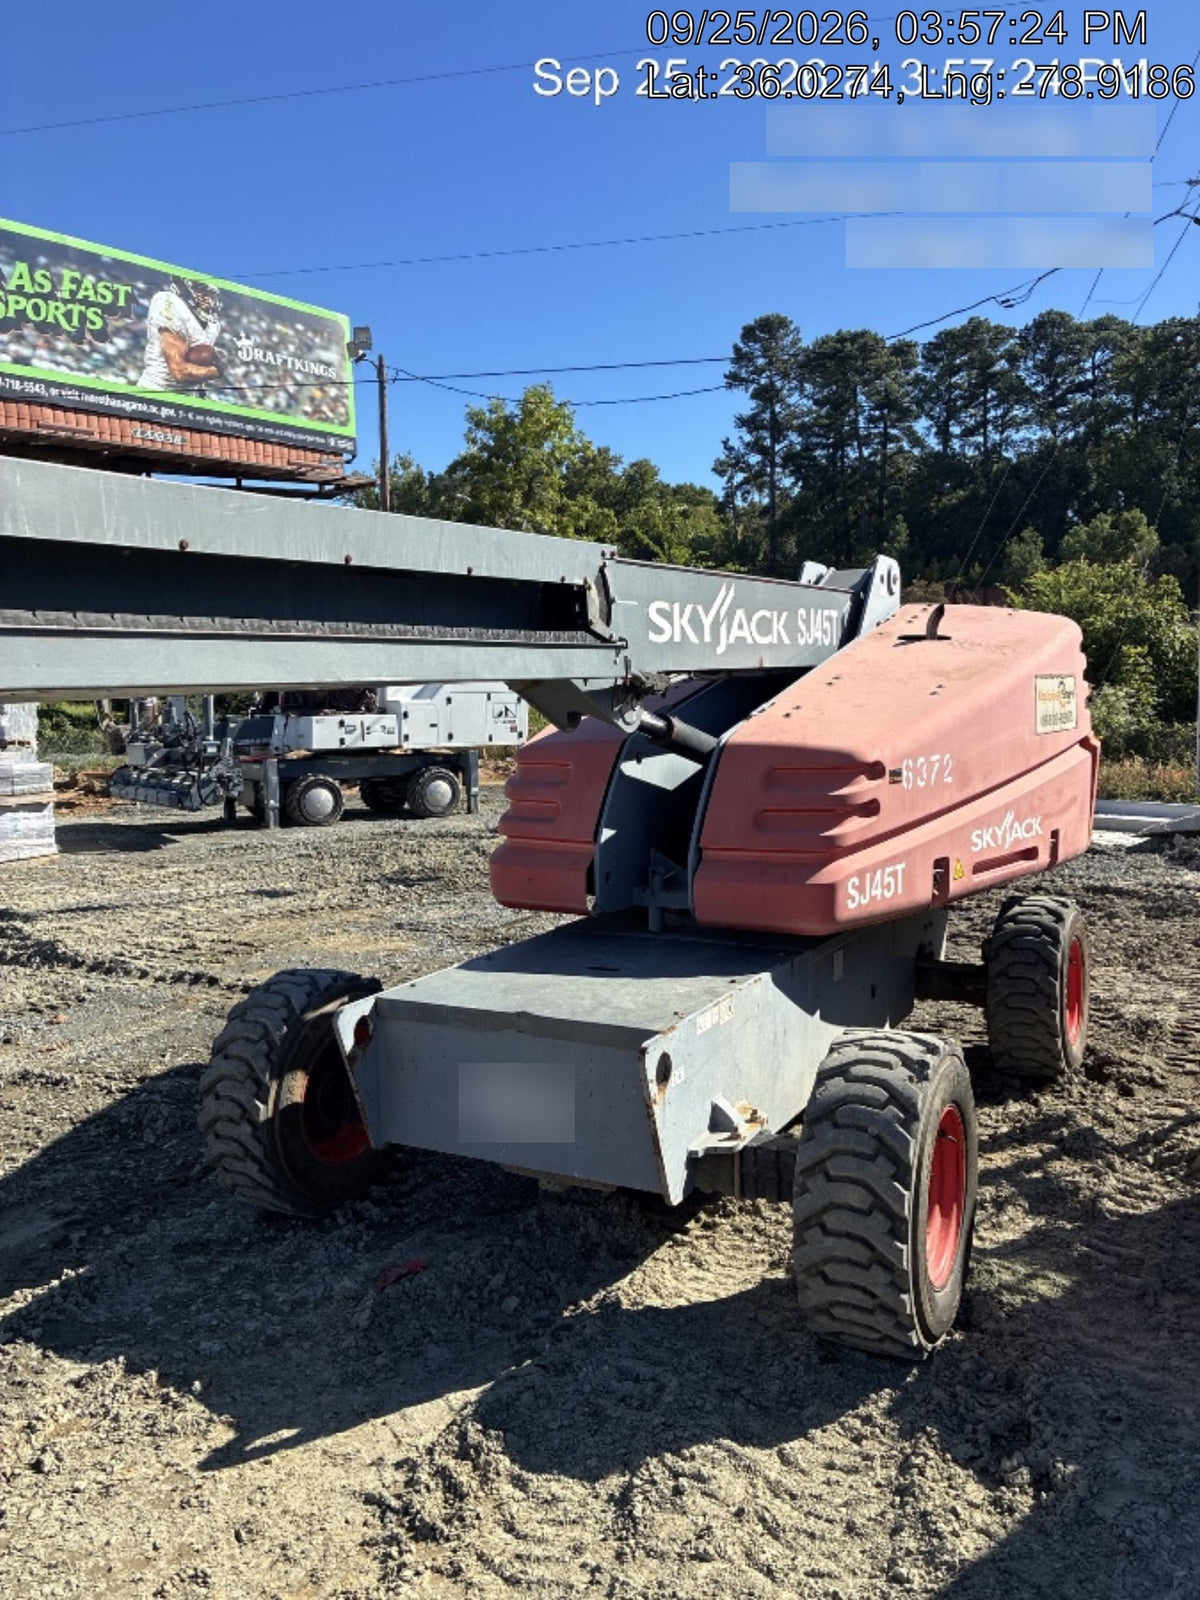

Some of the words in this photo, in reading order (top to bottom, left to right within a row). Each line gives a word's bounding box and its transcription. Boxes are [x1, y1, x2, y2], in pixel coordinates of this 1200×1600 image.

[6, 261, 53, 294] AS
[60, 268, 132, 307] FAST
[648, 583, 791, 655] SKYJACK
[797, 607, 840, 646] SJ45T
[901, 753, 955, 790] 6372
[970, 810, 1043, 852] SKYJACK
[846, 862, 907, 909] SJ45T
